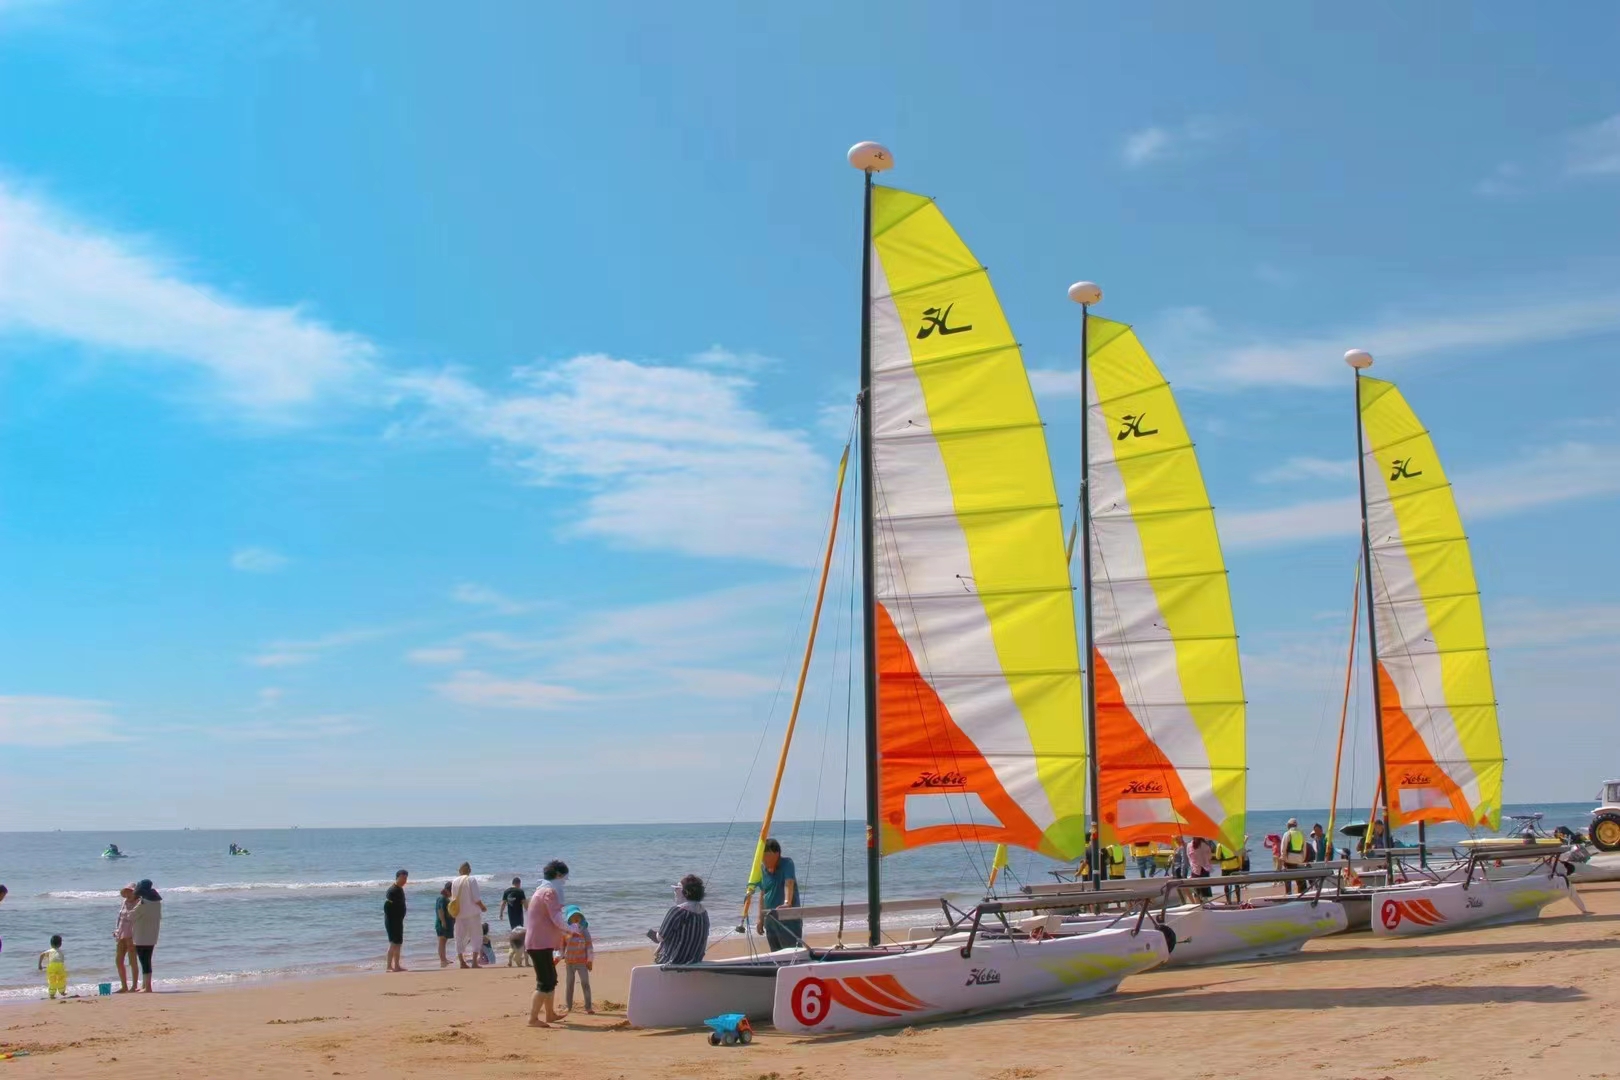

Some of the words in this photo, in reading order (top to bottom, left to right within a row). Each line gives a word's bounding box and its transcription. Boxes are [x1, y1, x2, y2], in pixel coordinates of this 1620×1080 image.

[911, 771, 967, 788] Hobie
[1121, 780, 1163, 794] Hobie
[1386, 903, 1396, 926] 2
[965, 967, 1001, 986] Hobie
[801, 983, 821, 1020] 6
